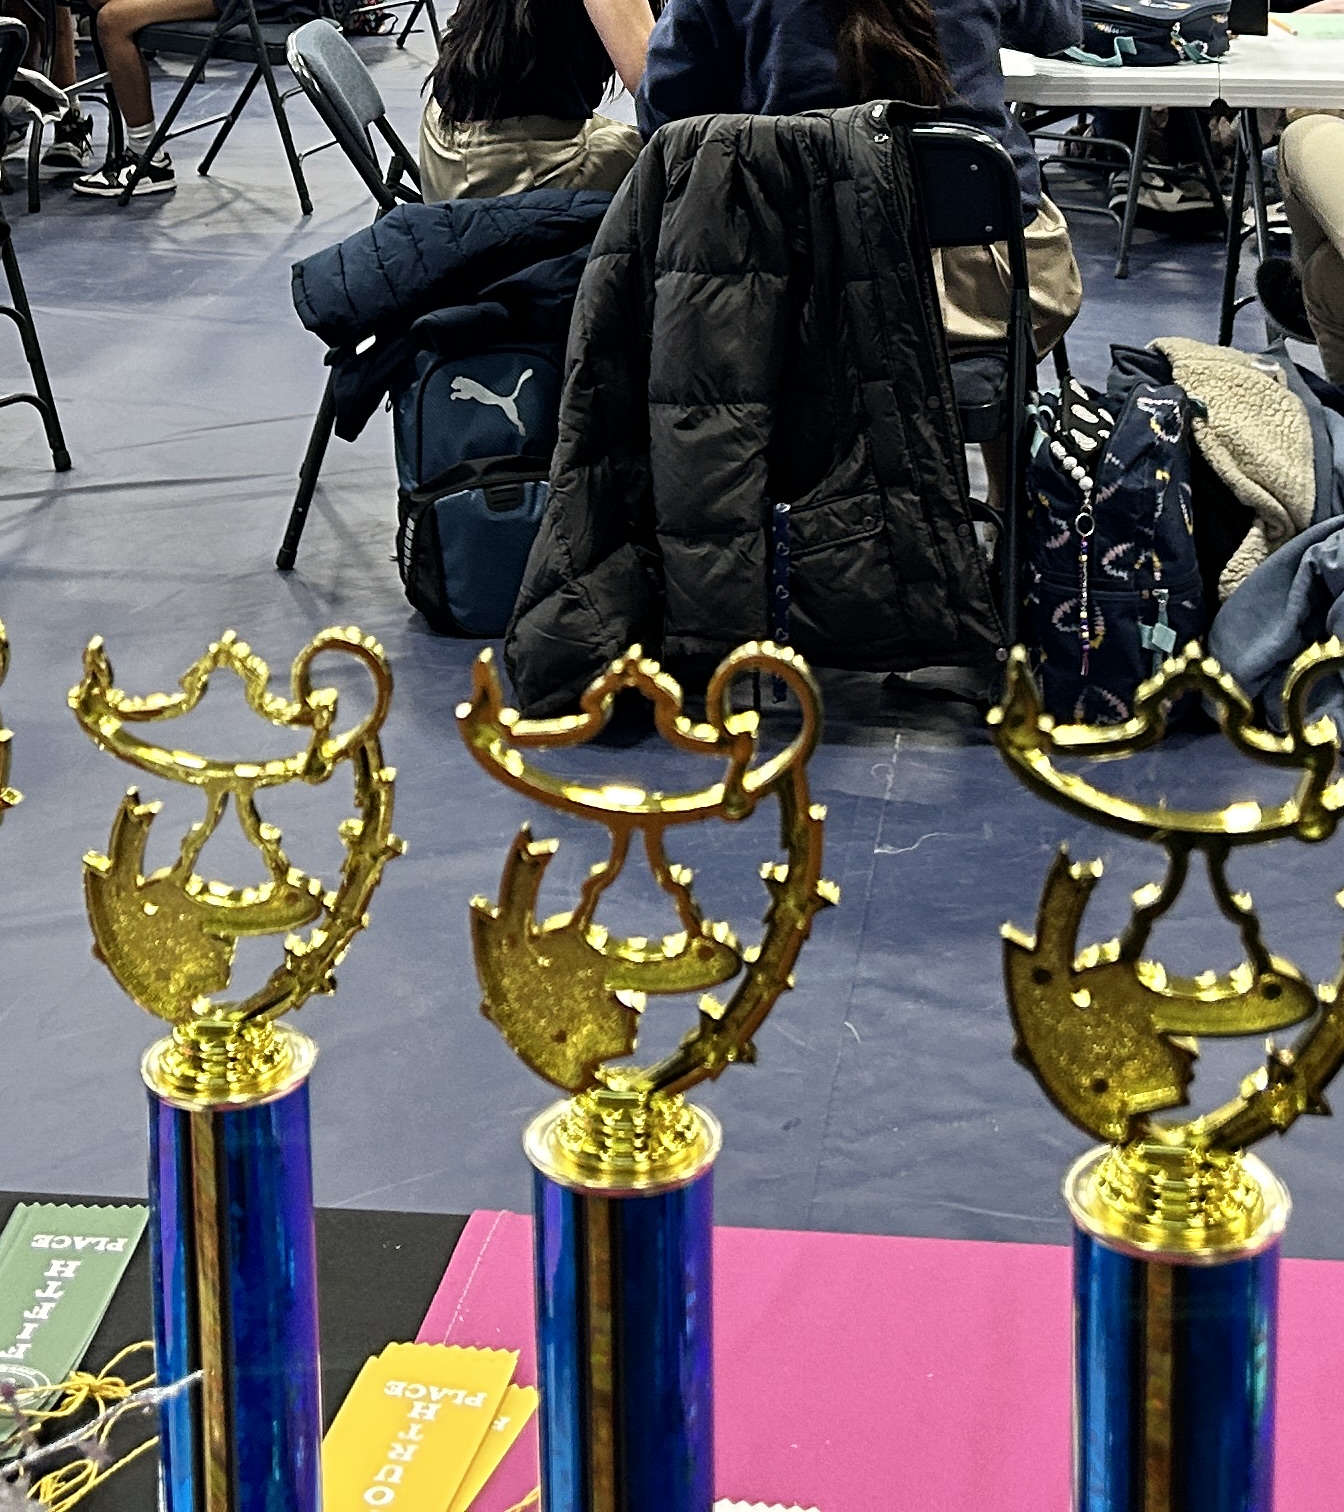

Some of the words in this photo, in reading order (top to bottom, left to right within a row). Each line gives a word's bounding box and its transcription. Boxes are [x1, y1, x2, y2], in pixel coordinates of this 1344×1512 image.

[31, 1234, 128, 1252] PLACE
[383, 1379, 488, 1407] PLACE
[363, 1400, 442, 1512] OURTH
